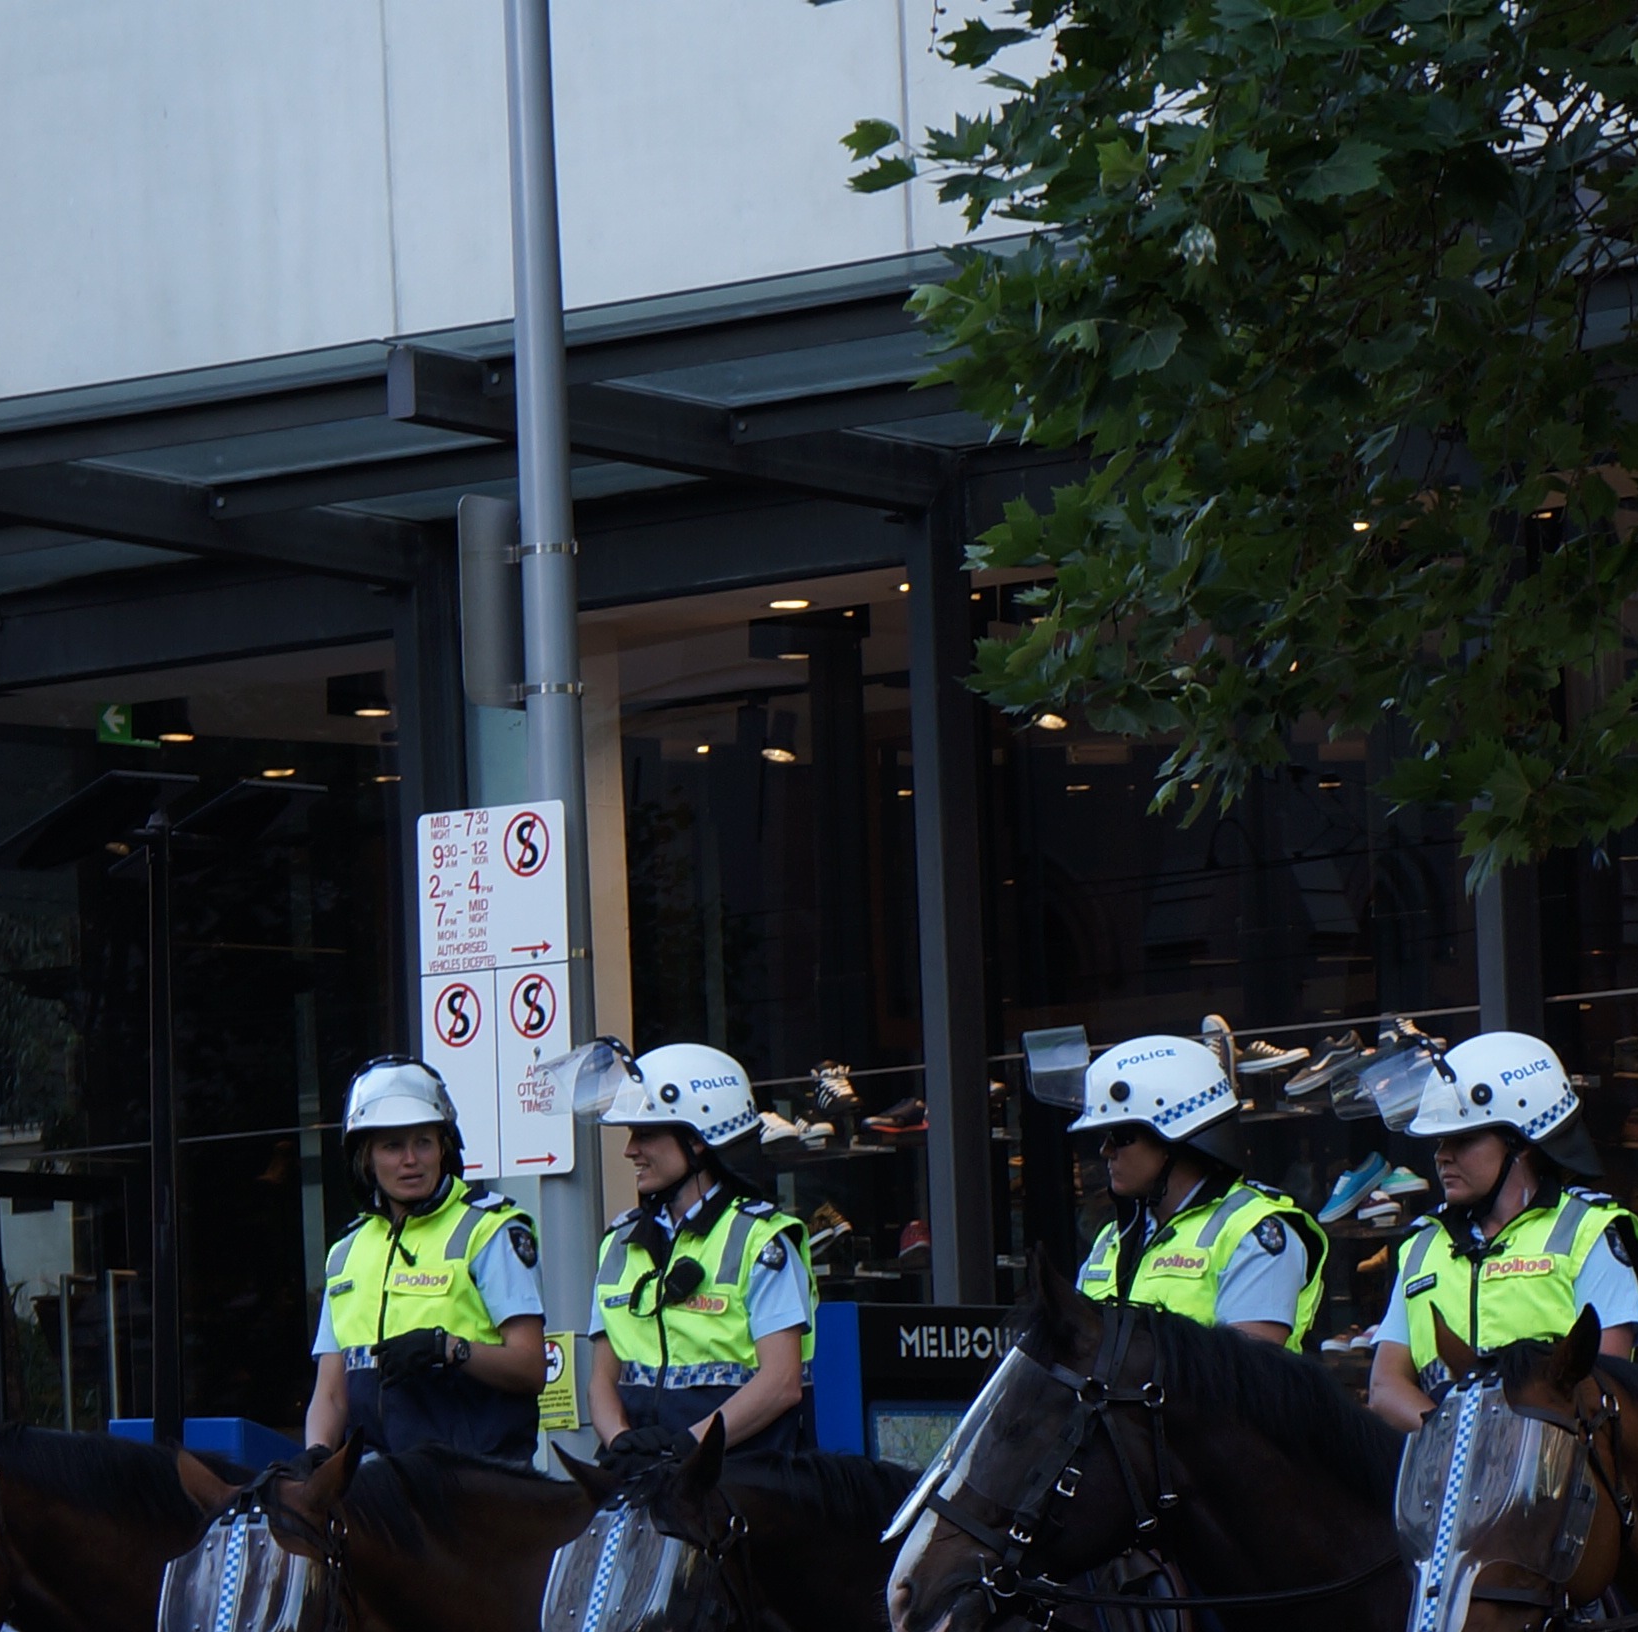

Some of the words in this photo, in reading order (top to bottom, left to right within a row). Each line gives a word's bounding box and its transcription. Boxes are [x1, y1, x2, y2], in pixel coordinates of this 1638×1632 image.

[430, 815, 450, 829] MID
[430, 829, 450, 840] NIGHT
[471, 841, 487, 855] 12
[469, 899, 488, 912] MID
[437, 930, 457, 941] MON
[468, 927, 487, 939] SUN
[437, 940, 488, 957] AUTHORISED
[429, 957, 461, 972] VEHICLES
[462, 954, 497, 970] EXCEPTED
[1116, 1048, 1176, 1070] POLICE
[1499, 1059, 1552, 1086] POLICE
[690, 1076, 739, 1093] POLICE
[1485, 1258, 1552, 1277] Police
[685, 1293, 724, 1311] olice
